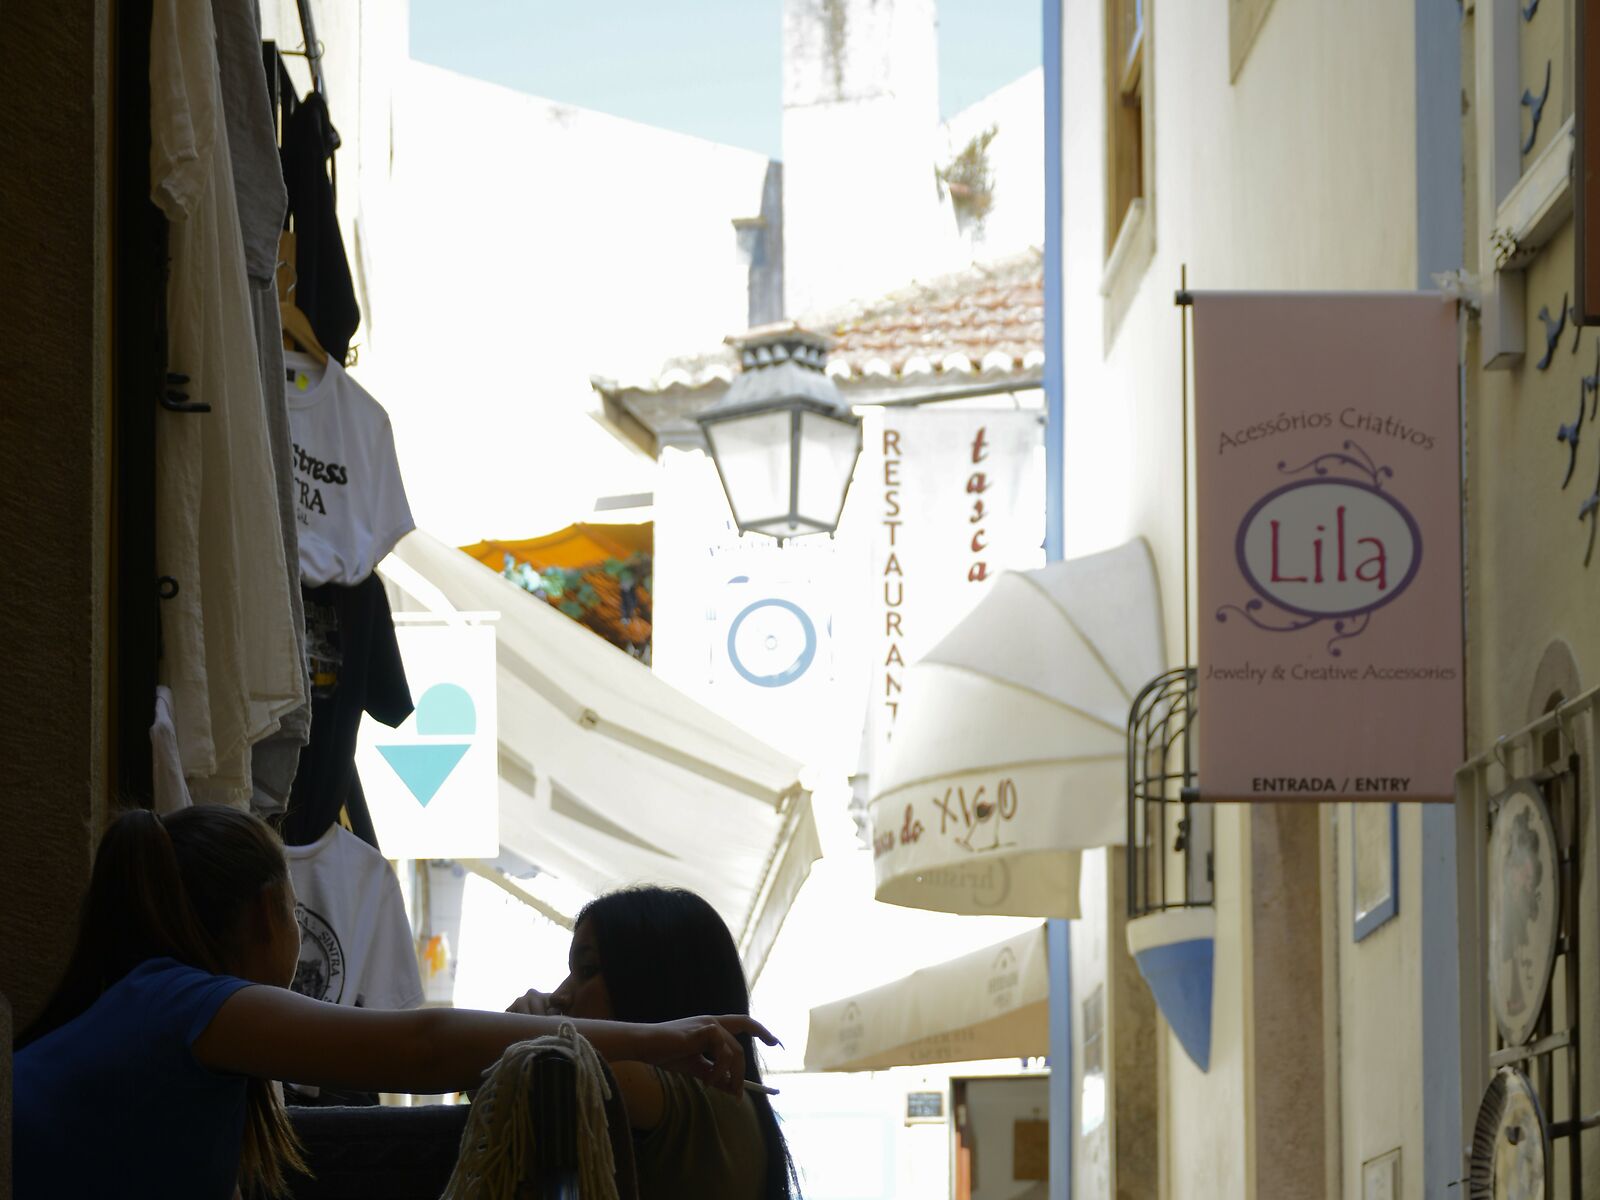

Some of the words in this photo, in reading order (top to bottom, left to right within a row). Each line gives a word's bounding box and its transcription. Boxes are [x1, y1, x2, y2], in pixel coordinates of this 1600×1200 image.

[1218, 409, 1333, 455] Acessórios
[1339, 406, 1437, 450] Criativos
[965, 426, 991, 582] tasca
[1269, 505, 1387, 591] Lila
[1206, 660, 1267, 686] Jewelry
[1271, 664, 1286, 680] &
[1290, 663, 1358, 680] Creative
[1361, 664, 1457, 680] Accessories
[1252, 777, 1336, 792] ENTRADA
[1341, 778, 1350, 793] /
[1355, 777, 1410, 792] ENTRY
[321, 930, 341, 977] SINTRA
